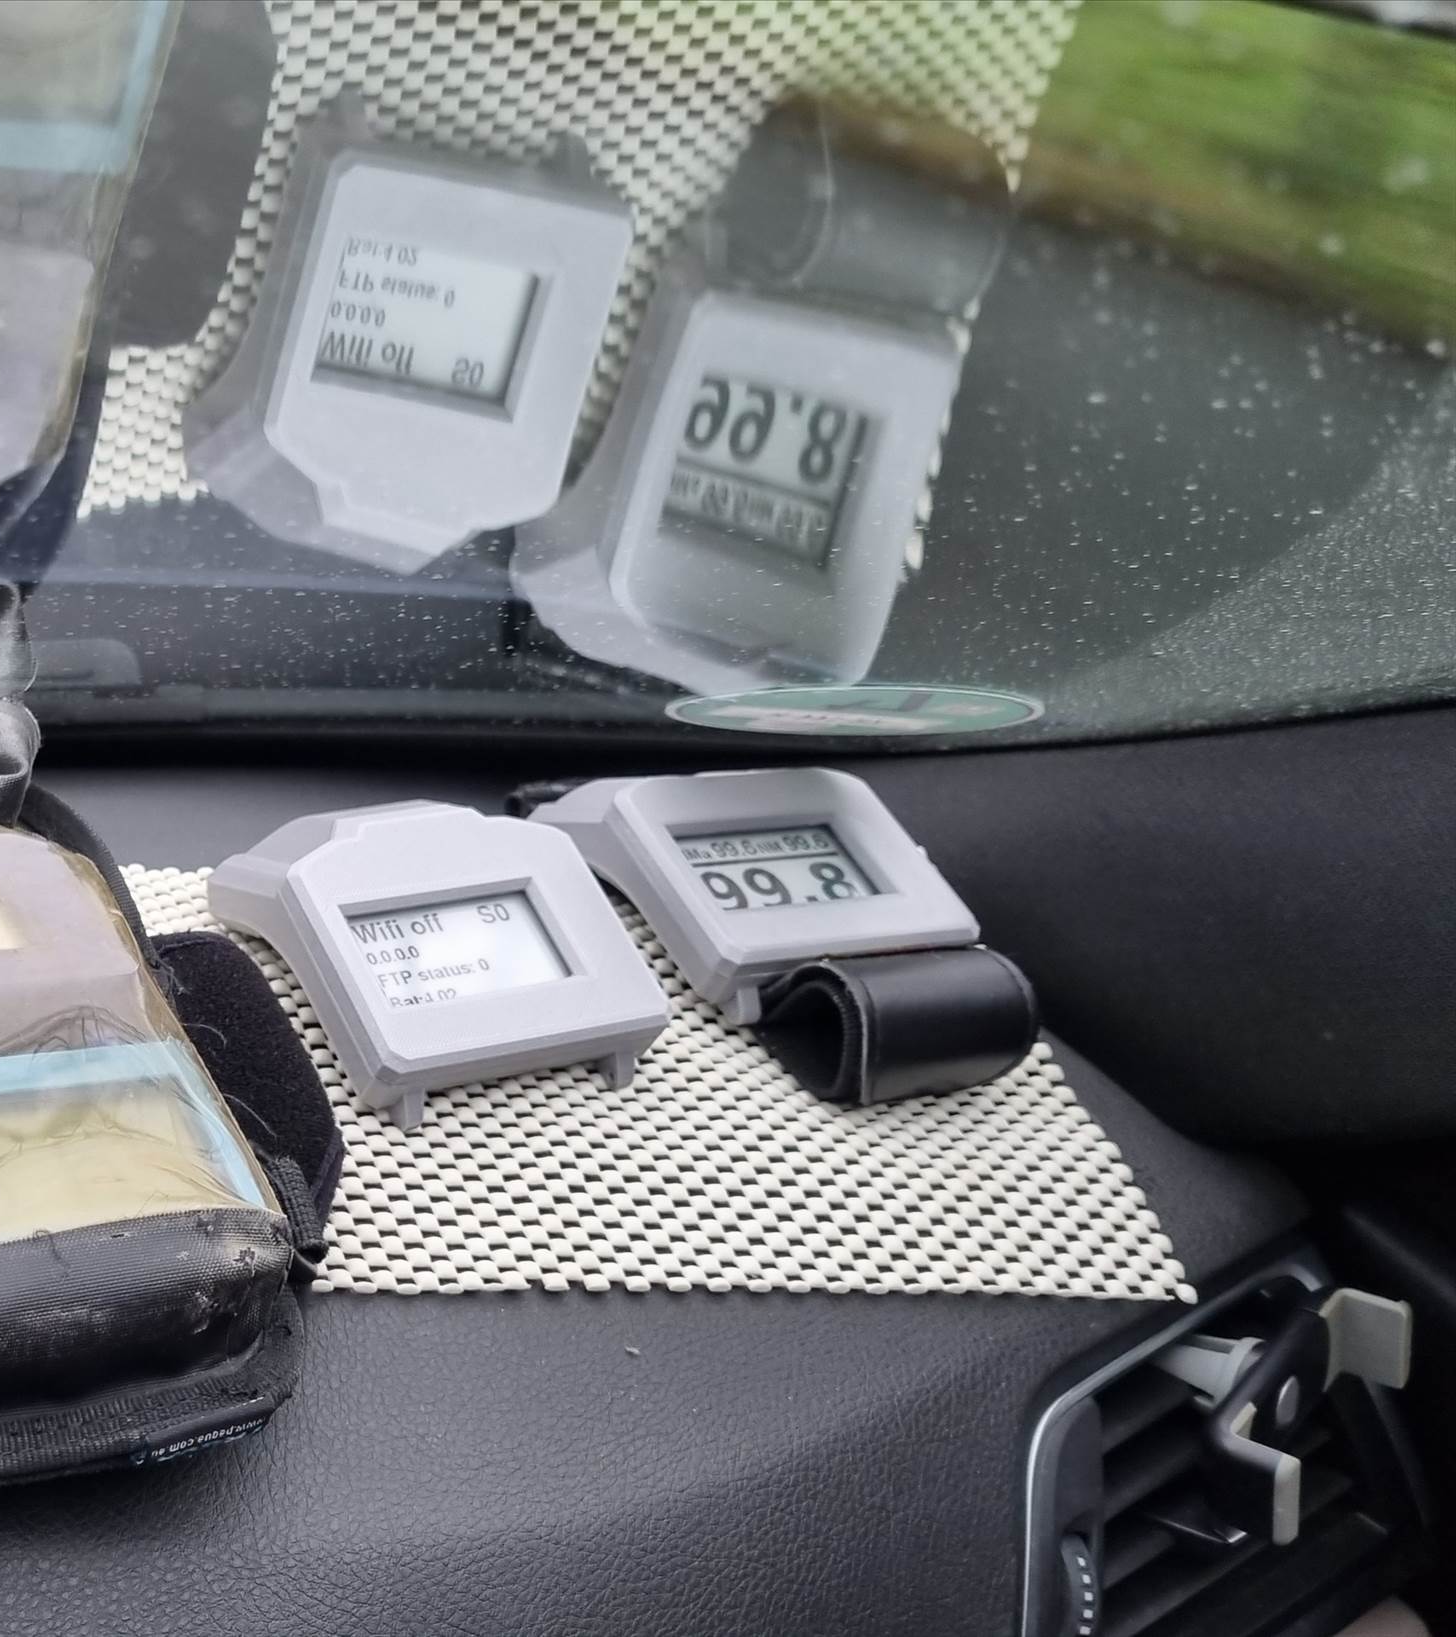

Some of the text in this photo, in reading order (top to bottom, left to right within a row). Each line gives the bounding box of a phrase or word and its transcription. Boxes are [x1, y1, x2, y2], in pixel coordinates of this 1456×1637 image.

[700, 861, 860, 912] 99.8
[351, 902, 512, 945] Wifi off S0
[366, 945, 420, 966] 0.0.0.0
[377, 970, 413, 991] FTP
[477, 957, 491, 973] 0
